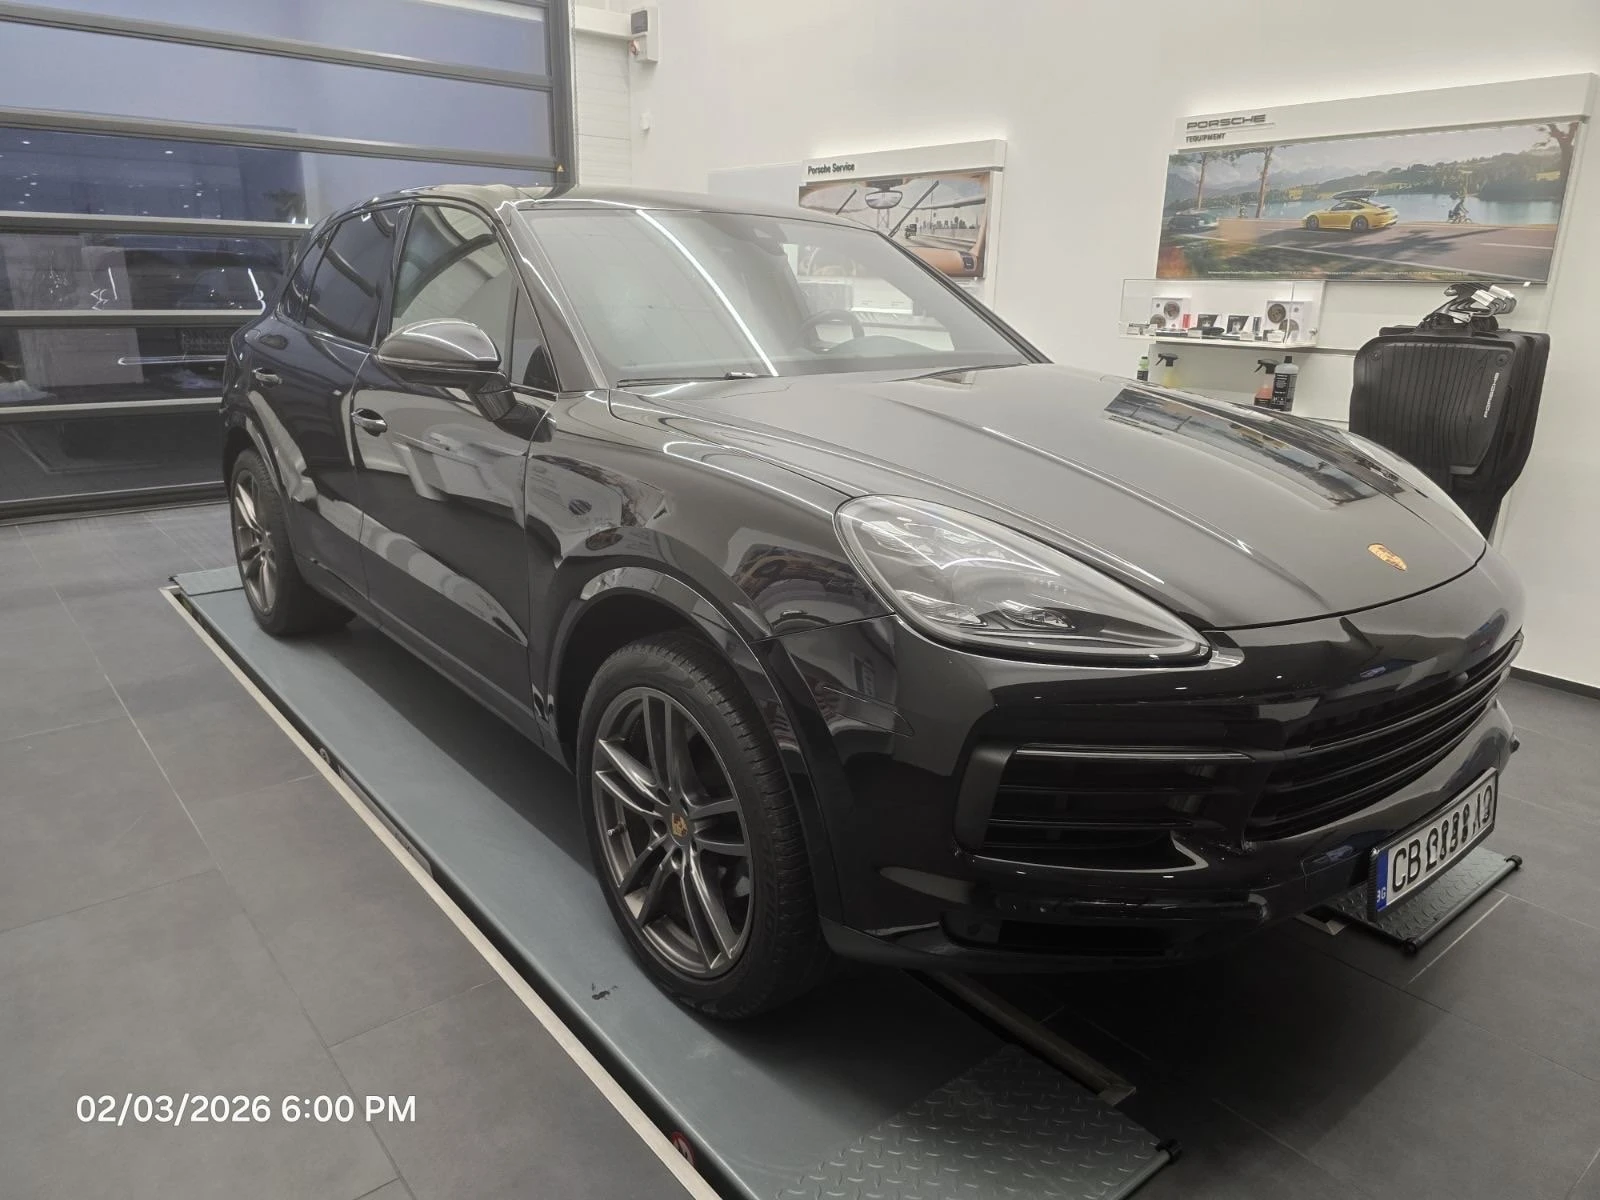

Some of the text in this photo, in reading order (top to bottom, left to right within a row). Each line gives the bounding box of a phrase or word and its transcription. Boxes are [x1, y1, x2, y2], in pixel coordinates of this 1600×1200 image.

[1187, 114, 1266, 129] PORSCHE
[1186, 133, 1226, 143] TEQUIPMENT
[808, 162, 855, 175] Porsche Service
[1484, 372, 1500, 418] PORSCHE
[1392, 839, 1421, 892] CB
